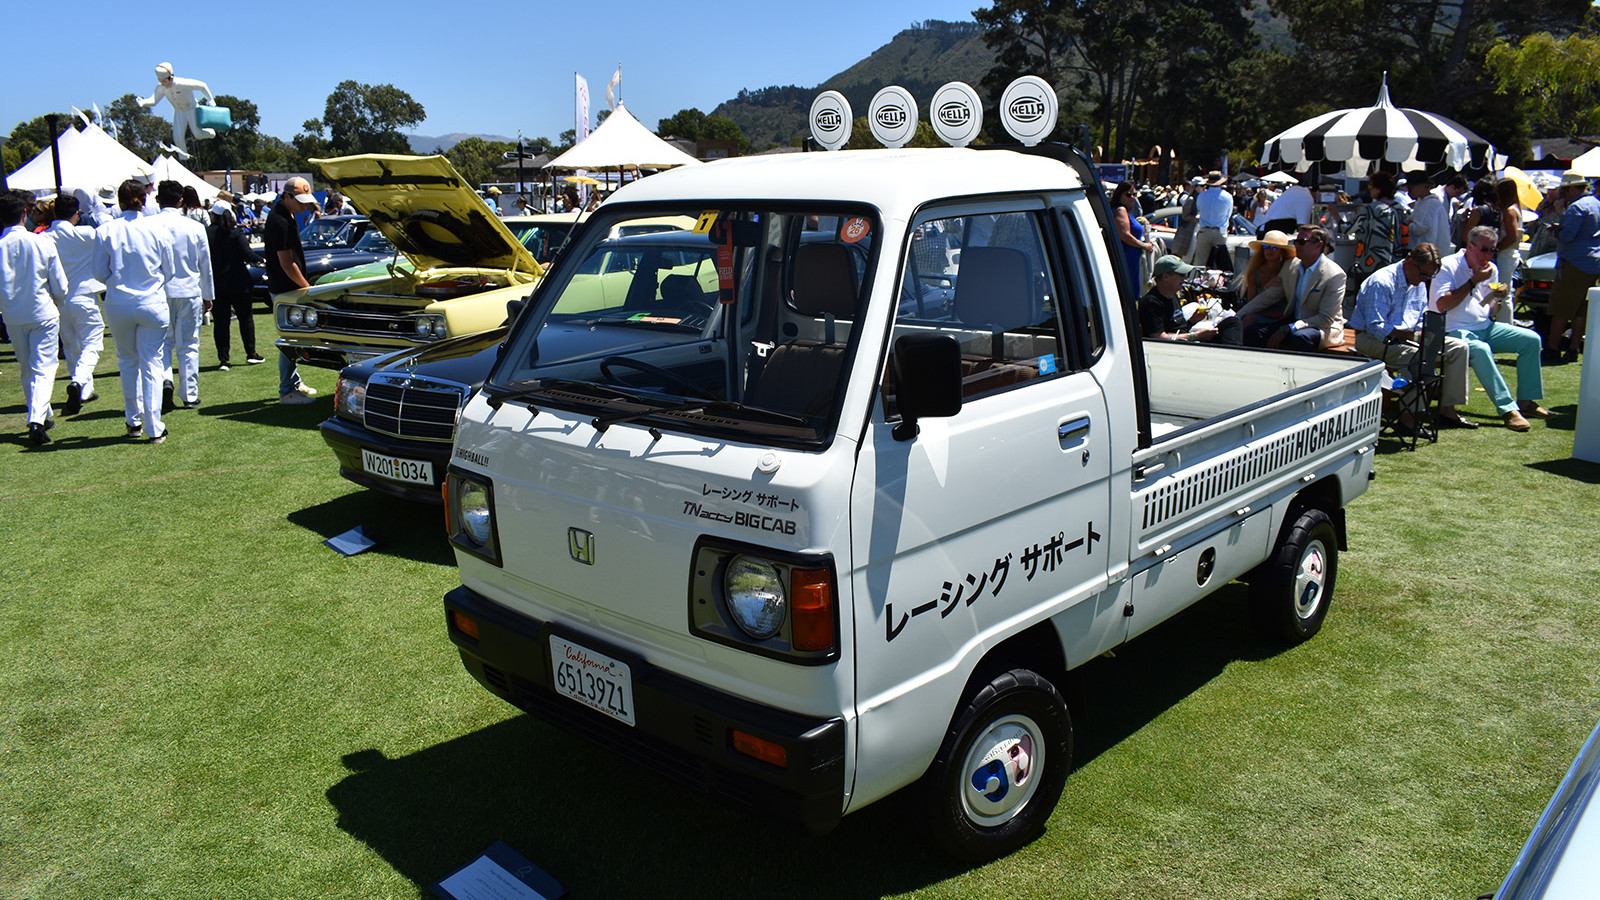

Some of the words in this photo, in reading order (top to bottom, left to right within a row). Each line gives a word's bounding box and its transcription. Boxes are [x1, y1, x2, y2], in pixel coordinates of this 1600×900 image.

[878, 109, 906, 123] HELLA
[941, 107, 970, 120] HELLA
[1012, 102, 1045, 116] HELLA
[817, 112, 842, 125] HELLA
[699, 217, 709, 231] 1
[849, 226, 861, 235] 26
[702, 483, 754, 503] レーシング
[756, 492, 800, 512] サポート
[885, 552, 1013, 643] レーシング
[1020, 520, 1101, 582] サポート
[565, 646, 616, 678] California
[557, 661, 628, 716] 65139Z1
